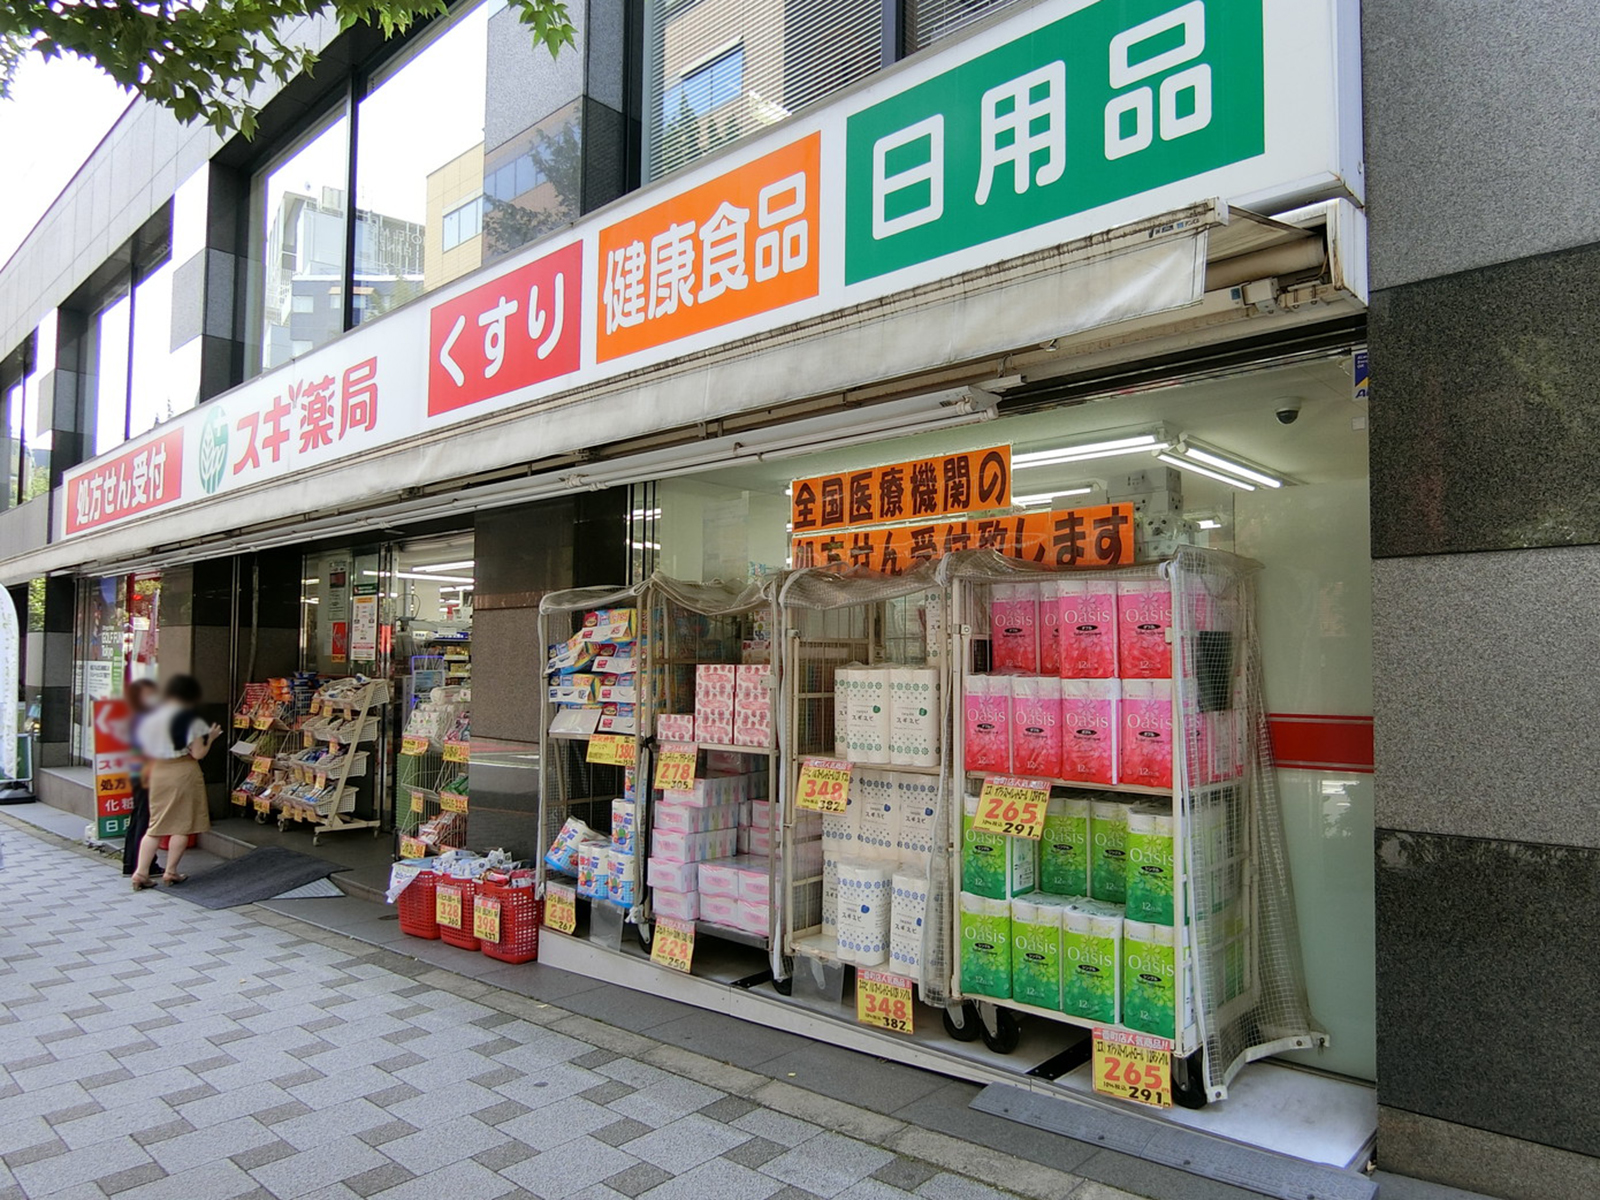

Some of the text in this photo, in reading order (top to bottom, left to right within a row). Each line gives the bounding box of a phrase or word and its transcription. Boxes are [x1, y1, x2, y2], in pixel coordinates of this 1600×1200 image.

[872, 0, 1212, 240] 日用品
[602, 171, 809, 335] 健康食品
[439, 272, 565, 388] くすり
[232, 356, 378, 475] スギ薬局
[76, 443, 167, 526] 処方せん受付
[793, 451, 1006, 530] 全国医療機関の
[995, 612, 1033, 627] Oasis
[1065, 608, 1110, 624] Oasis
[968, 708, 1006, 722] Oasis
[1015, 711, 1056, 726] Oasis
[1066, 712, 1109, 728] Oasis
[1043, 828, 1084, 844] Oasis
[1095, 833, 1124, 848] Oas
[965, 926, 1006, 944] Oasis
[1015, 936, 1057, 954] Oasis
[1067, 946, 1112, 967] Oasis
[1128, 955, 1174, 977] Oasis
